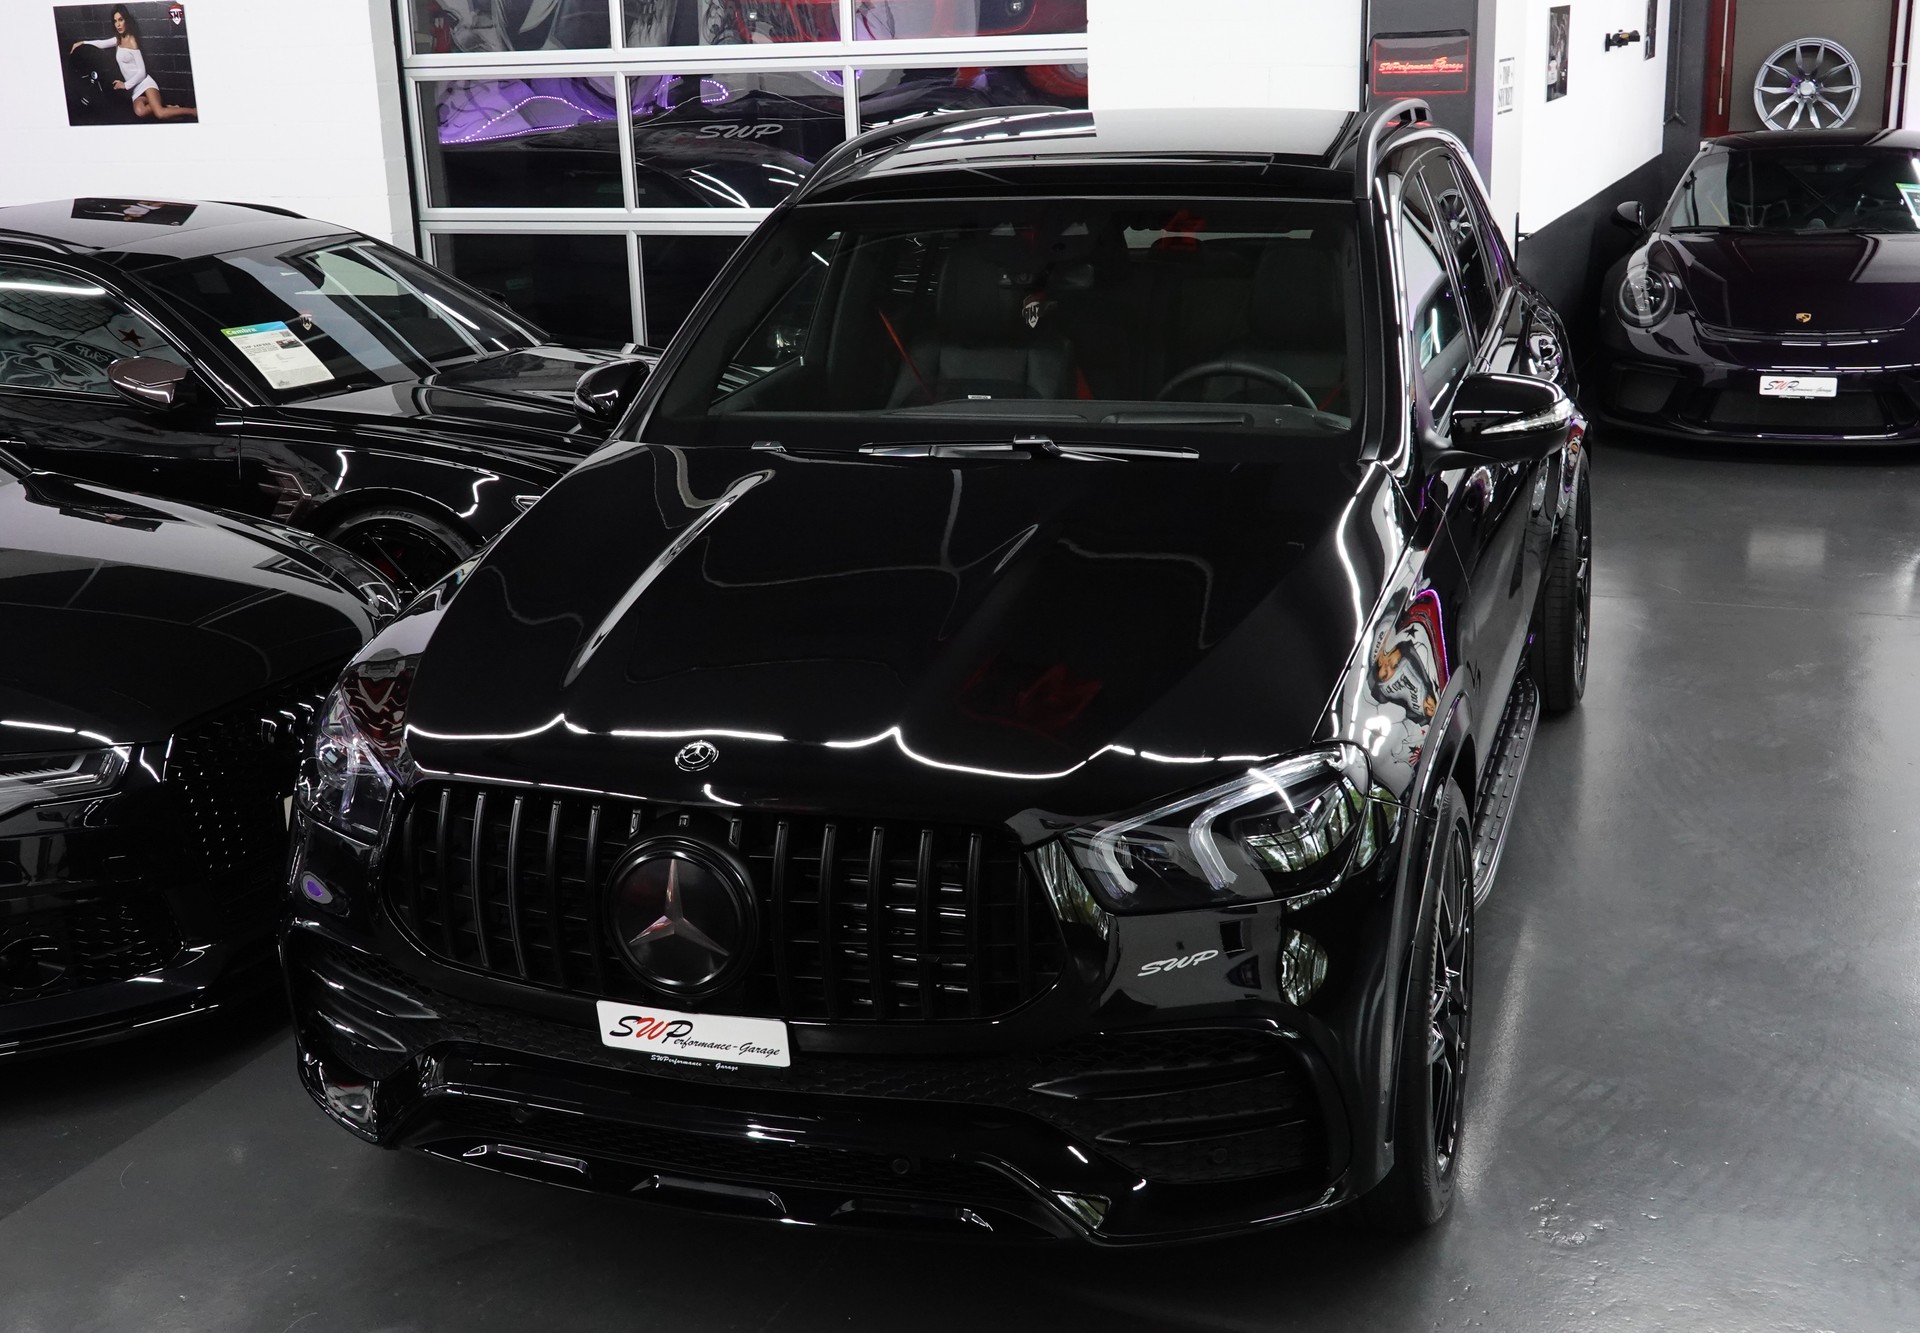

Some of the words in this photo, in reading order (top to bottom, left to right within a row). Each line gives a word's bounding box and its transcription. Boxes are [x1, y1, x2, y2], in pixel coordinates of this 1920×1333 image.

[695, 123, 784, 139] SWP
[1137, 949, 1219, 977] SWP
[650, 1054, 703, 1067] SWPerformance
[715, 1062, 739, 1072] Garage
